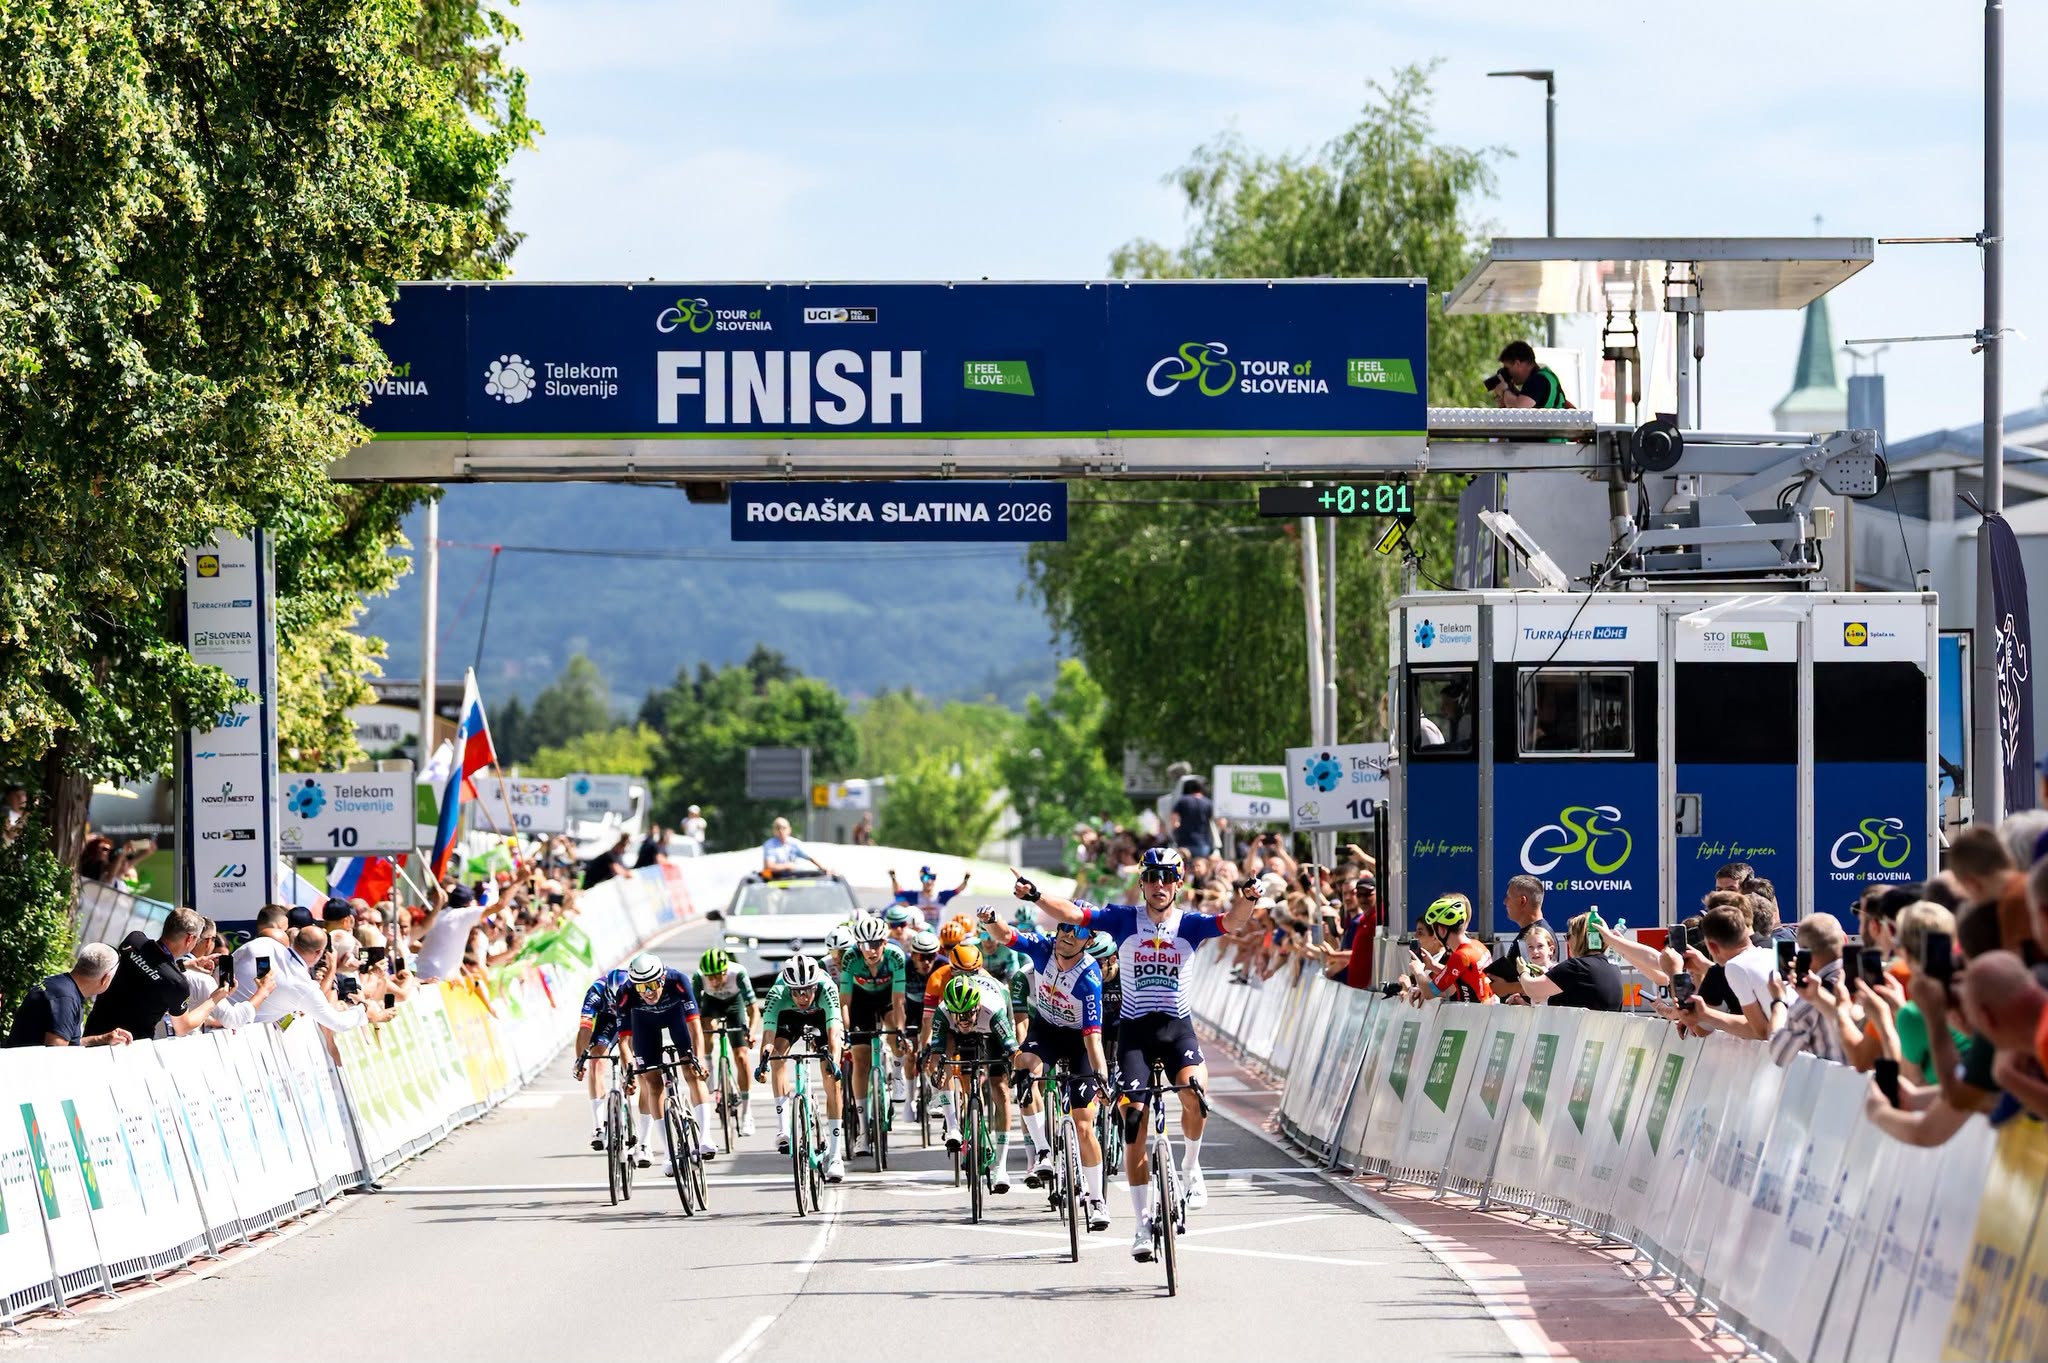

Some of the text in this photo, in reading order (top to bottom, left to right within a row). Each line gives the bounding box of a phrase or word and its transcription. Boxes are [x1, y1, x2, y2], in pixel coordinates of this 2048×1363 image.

[715, 309, 762, 320] TOUR of
[807, 311, 831, 321] UCI
[715, 321, 773, 332] SLOVENIA
[393, 362, 411, 378] of
[544, 363, 618, 379] Telekom
[967, 364, 1001, 374] I FEEL
[1240, 360, 1312, 376] TOUR of
[1350, 361, 1384, 371] I FEEL
[361, 381, 429, 396] OVENIA
[544, 381, 618, 400] Slovenije
[656, 349, 923, 425] FINISH
[1240, 379, 1329, 394] SLOVENIA
[1318, 485, 1411, 513] +0:01
[746, 498, 1052, 523] ROGAŠKA SLATINA 2026
[1439, 623, 1472, 633] Telekom
[1523, 627, 1625, 640] TURRACHER HÖHE
[1439, 634, 1472, 645] Slovenije
[1703, 632, 1725, 641] STO
[1349, 755, 1389, 770] Telek
[333, 786, 394, 798] Telekom
[334, 800, 394, 814] Slovenije
[1248, 802, 1271, 815] 50
[1346, 797, 1374, 819] 10
[202, 831, 221, 840] UCI
[327, 826, 358, 848] 10
[1412, 839, 1473, 857] fight for green
[1696, 841, 1776, 860] fight for green
[1830, 872, 1911, 881] TOUR of SLOVENIA
[1555, 880, 1568, 891] of
[1570, 880, 1632, 891] SLOVENIA
[1134, 951, 1181, 965] Red Bull
[129, 952, 160, 981] vittoria
[1134, 964, 1179, 979] BORA
[1136, 978, 1178, 989] hansgrohe
[1086, 994, 1098, 1021] BOSS
